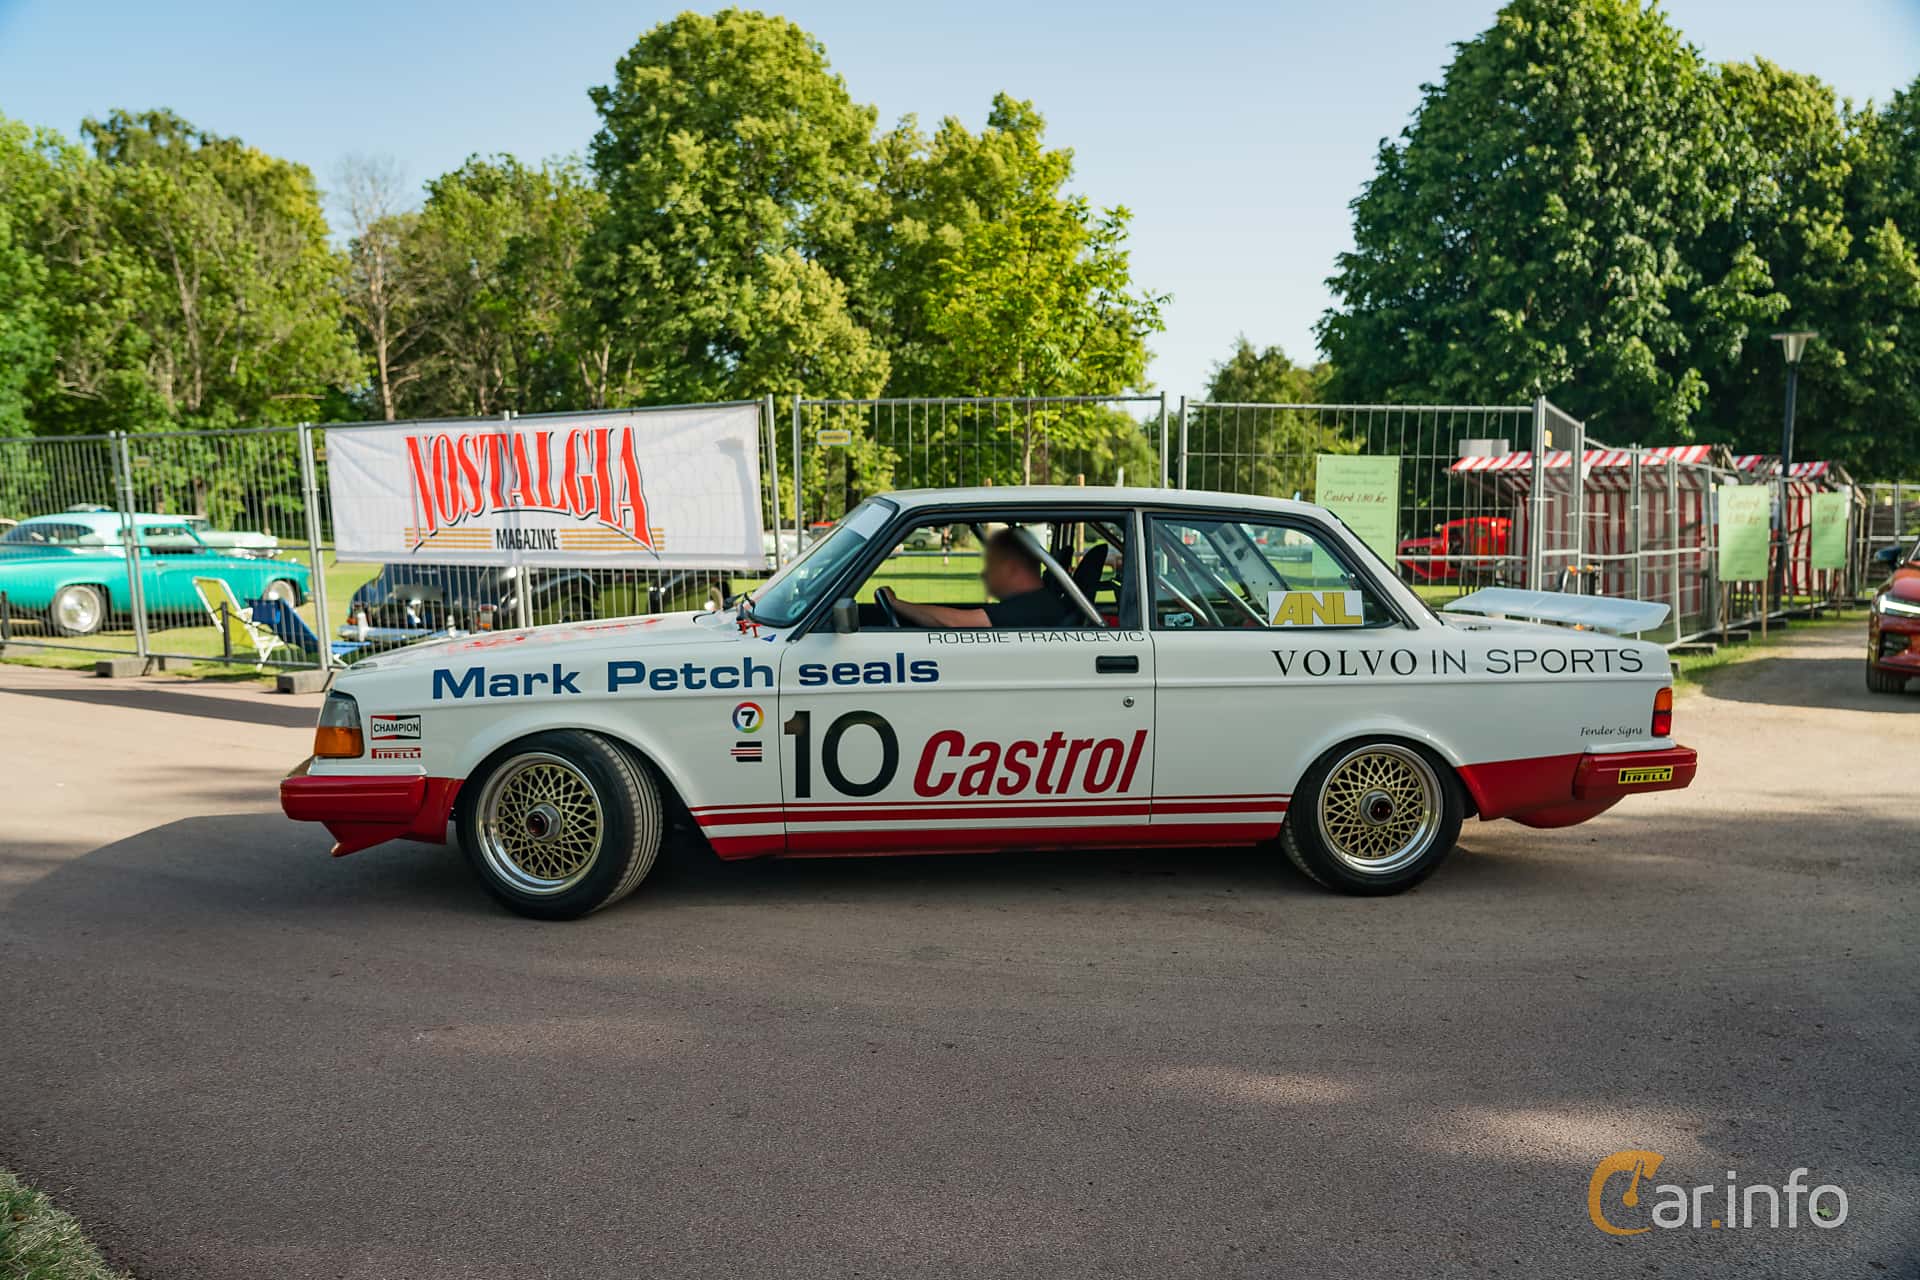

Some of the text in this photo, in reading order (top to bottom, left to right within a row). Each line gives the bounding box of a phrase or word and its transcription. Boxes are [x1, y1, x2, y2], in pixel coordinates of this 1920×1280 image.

[404, 425, 660, 557] NOSTALGIA
[496, 528, 559, 550] MAGAZINE
[1271, 592, 1363, 625] ANL
[927, 631, 1145, 644] ROBBIE FRANCEVIC
[1271, 648, 1644, 677] VOLVO IN SPORTS
[432, 652, 940, 700] Mark Petch seals
[373, 723, 419, 733] CHAMPION
[741, 710, 756, 727] 7
[1580, 725, 1643, 738] Fender Signs
[371, 747, 421, 759] PIRELLI
[784, 710, 899, 798] 10
[913, 729, 1149, 798] Castrol
[1620, 767, 1671, 782] PIRELLI
